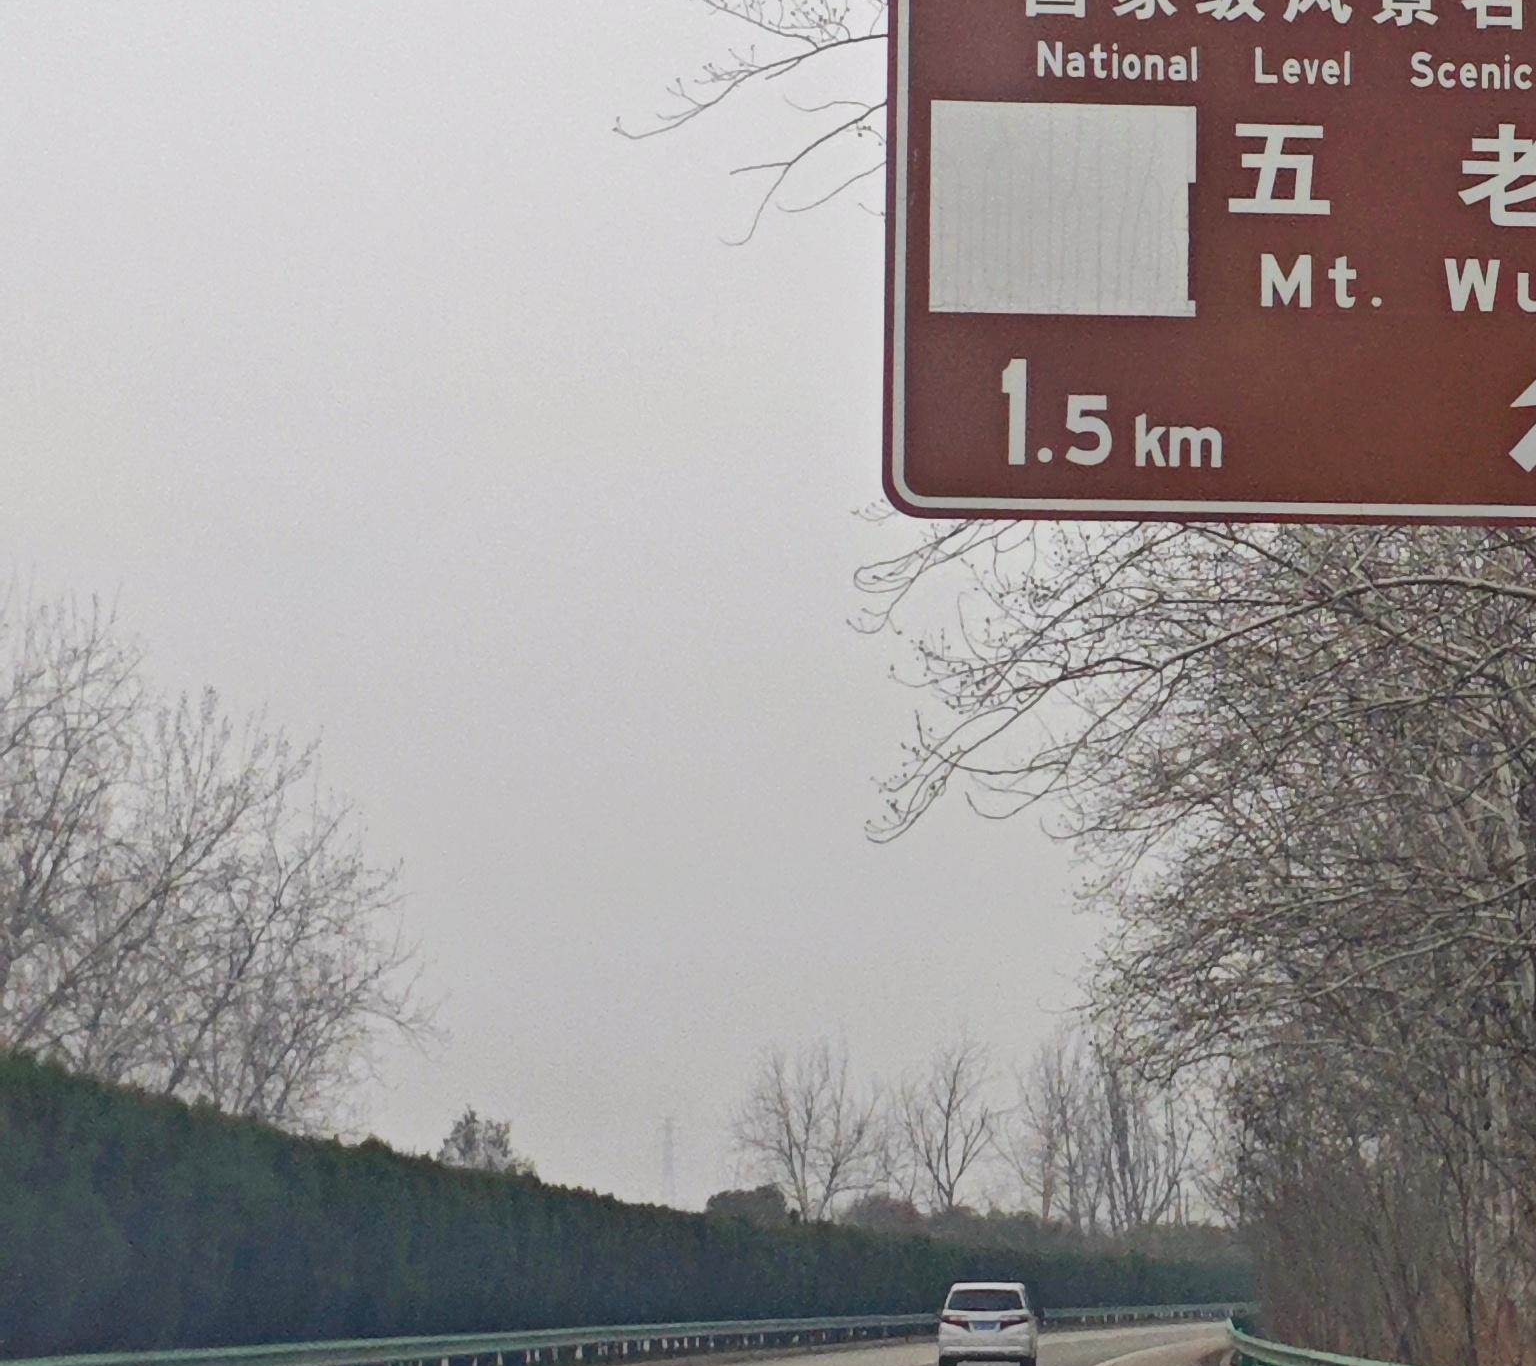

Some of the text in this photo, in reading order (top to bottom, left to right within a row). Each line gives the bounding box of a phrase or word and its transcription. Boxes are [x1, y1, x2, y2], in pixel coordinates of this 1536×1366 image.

[1037, 40, 1198, 82] National
[1254, 46, 1351, 86] Level
[1410, 51, 1533, 90] Scenic
[1260, 253, 1382, 309] Mt.
[1001, 358, 1222, 468] 1.5 km
